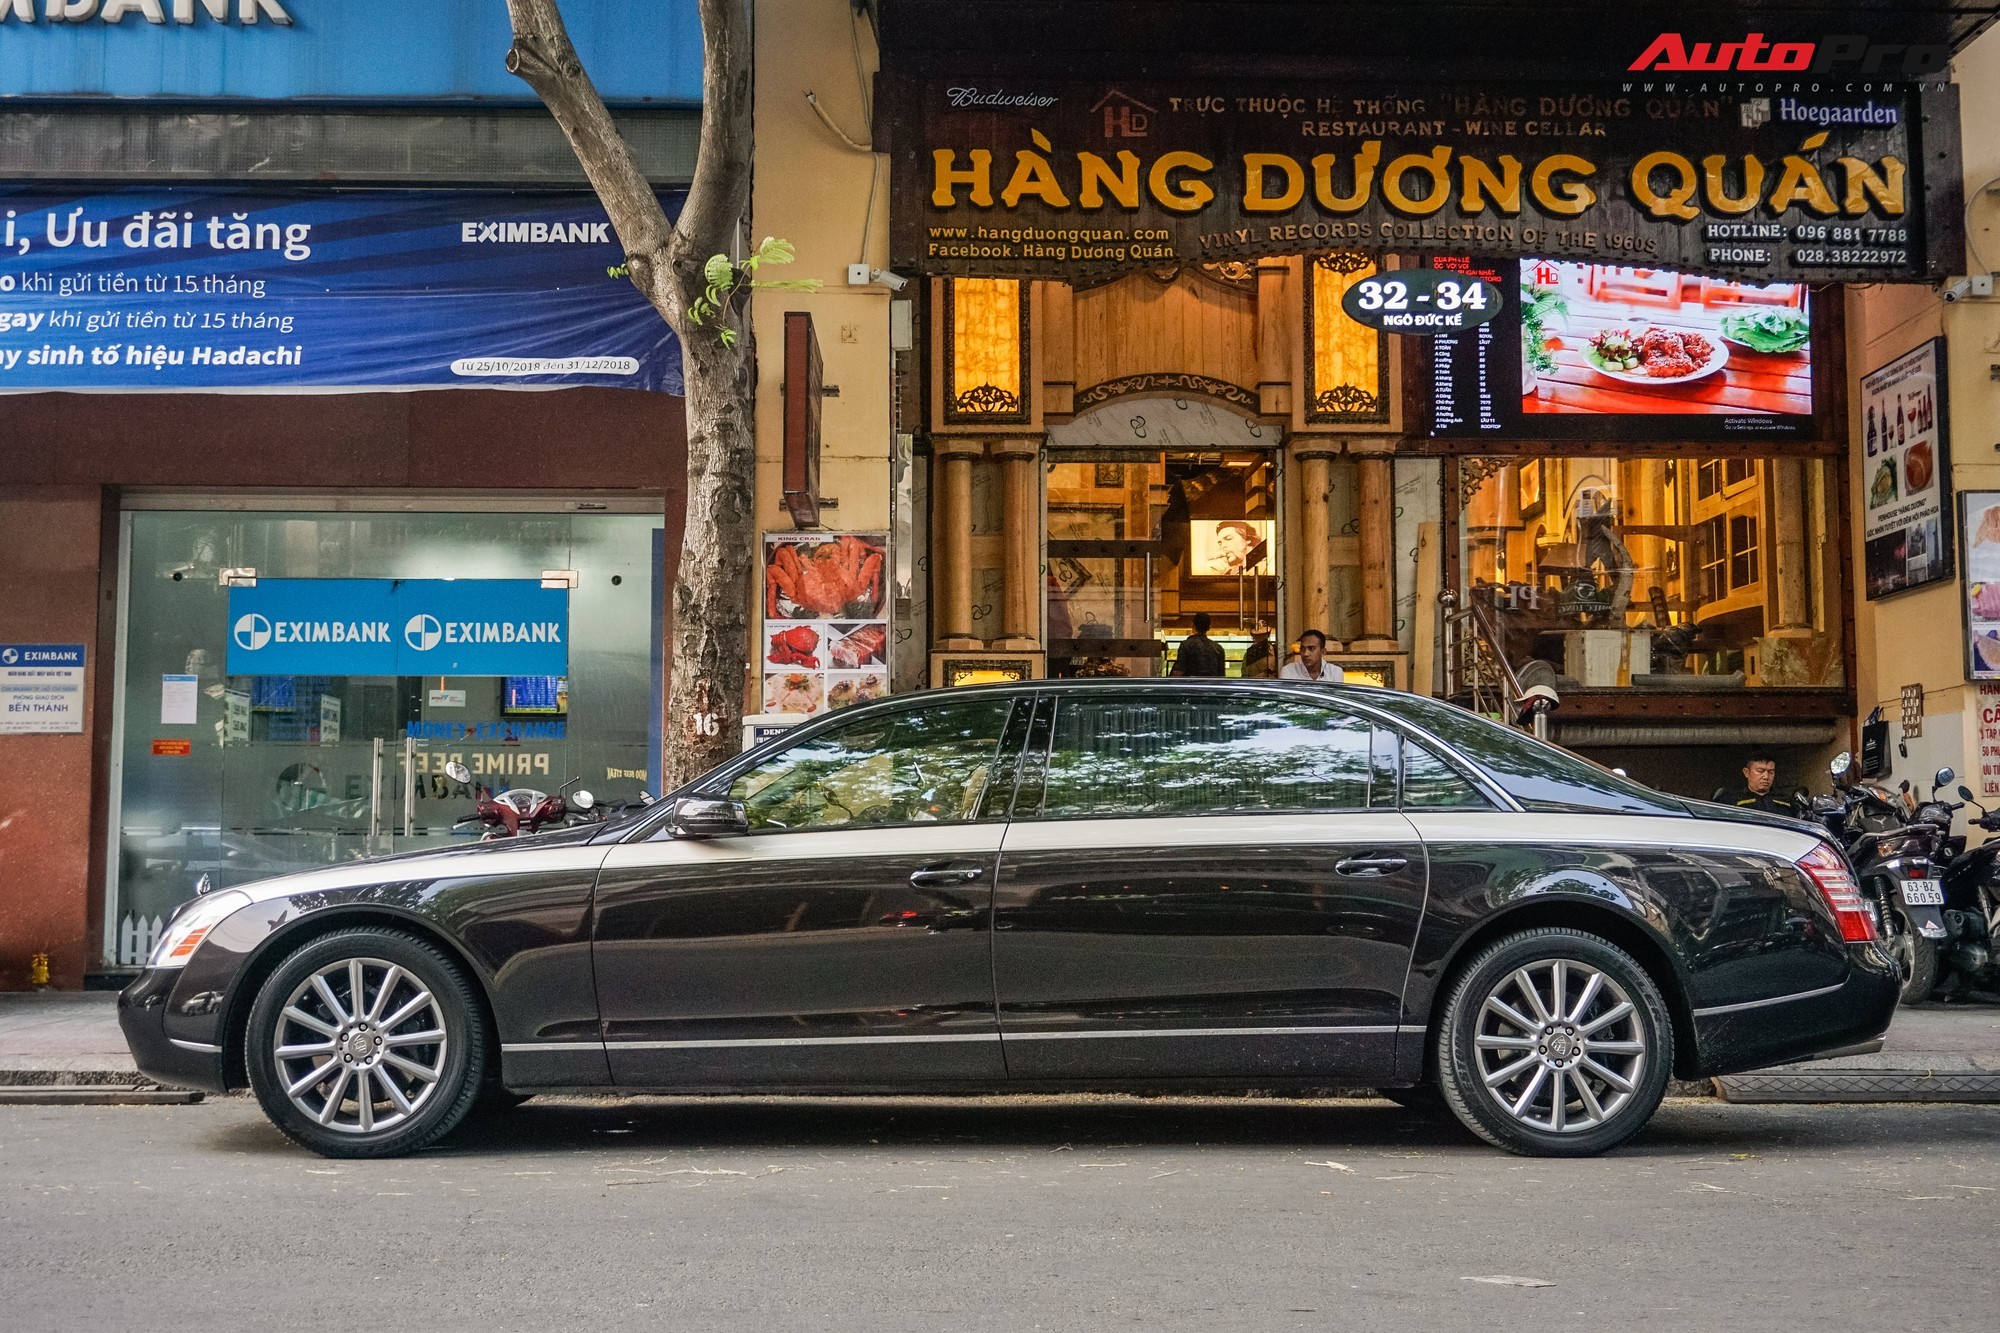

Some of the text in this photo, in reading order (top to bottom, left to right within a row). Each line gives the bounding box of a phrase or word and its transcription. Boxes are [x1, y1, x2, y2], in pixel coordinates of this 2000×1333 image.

[947, 87, 1059, 107] Budweiser
[1169, 96, 1225, 117] TRỰC
[1236, 94, 1306, 118] THUỘC
[1780, 98, 1898, 125] Hoegaarden
[1302, 121, 1445, 137] RESTAURANT
[1465, 121, 1517, 136] WINE
[1525, 121, 1607, 136] CELLAR
[932, 128, 1906, 220] HÀNG DƯƠNG QUÁN
[47, 207, 108, 247] Ưu
[122, 211, 193, 248] đãi
[206, 212, 311, 261] tăng
[462, 221, 610, 243] EXIMBANK
[929, 226, 1169, 243] www.hangduongquan.com
[1199, 222, 1658, 254] VINYL RECORDS COLLECTION OF THE 1960S
[1708, 224, 1908, 242] HOTLINE: 096 881 7788
[1023, 244, 1066, 260] Hàng
[1071, 245, 1125, 261] Dương
[1130, 244, 1174, 259] Quán
[1711, 248, 1907, 263] PHONE: 028.38222972
[22, 272, 53, 292] khi
[60, 271, 92, 297] gửi
[98, 271, 139, 293] tiền
[145, 273, 168, 293] từ
[203, 273, 266, 298] tháng
[1358, 281, 1408, 310] 32
[1437, 281, 1487, 310] 34
[49, 311, 81, 328] khi
[86, 310, 121, 332] gửi
[126, 310, 167, 329] tiền
[173, 312, 196, 329] từ
[201, 313, 226, 329] 15
[231, 312, 295, 333] tháng
[1383, 313, 1463, 326] NGÔ ĐỨC KẾ
[27, 345, 84, 366] sinh
[92, 343, 122, 366] tố
[126, 344, 188, 370] hiệu
[191, 345, 303, 366] Hadachi
[477, 361, 541, 372] 25/10/2018
[566, 360, 631, 371] 31/12/2018
[275, 621, 391, 643] EXIMBANK
[445, 622, 561, 643] EXIMBANK
[24, 652, 78, 661] EXIMBANK
[8, 701, 68, 712] BẾN THÀNH
[406, 721, 566, 739] MONEY EXCHANGE
[693, 713, 720, 736] 16
[1906, 893, 1941, 903] 660.59
